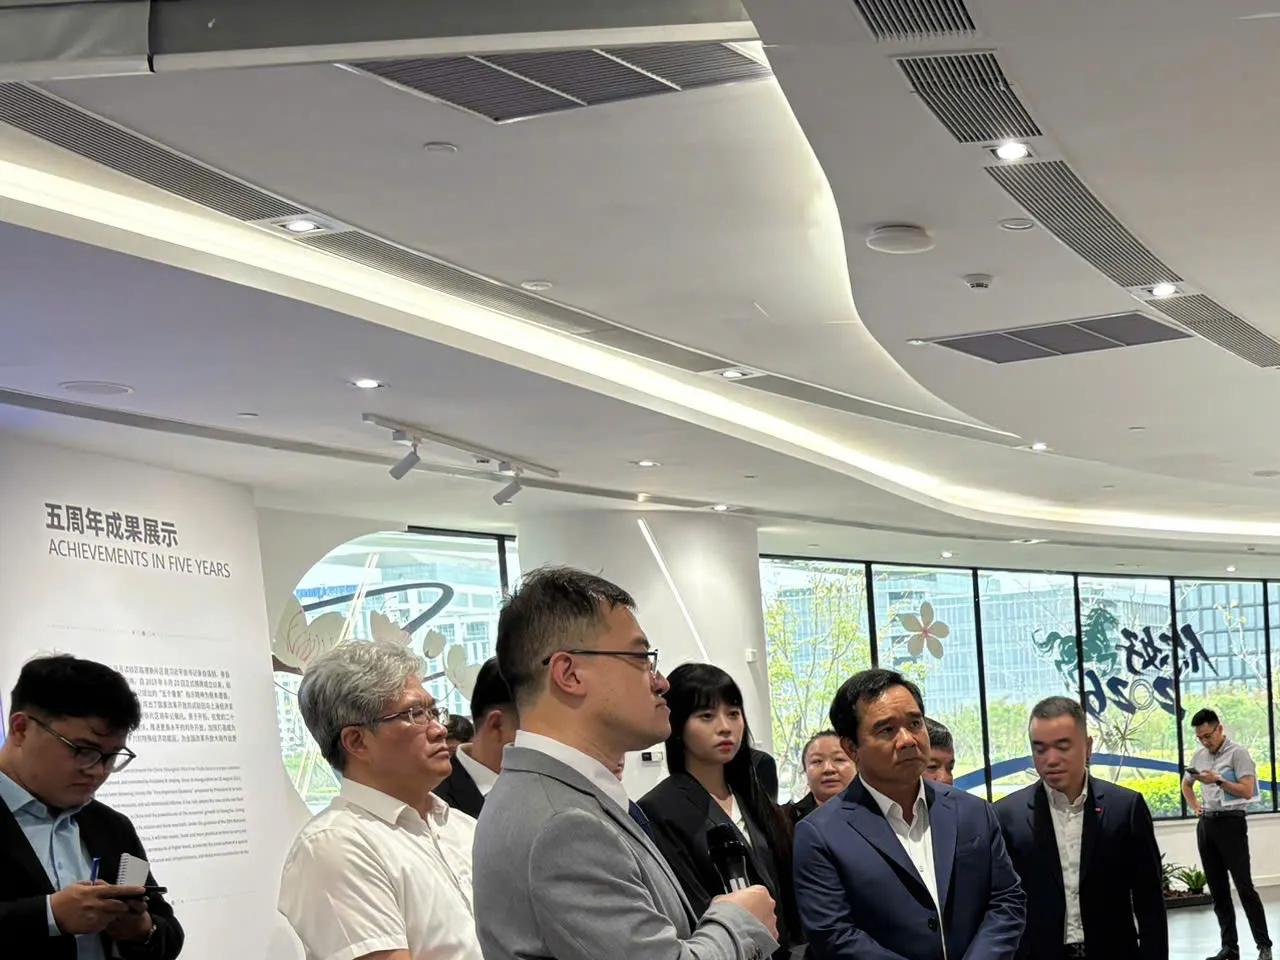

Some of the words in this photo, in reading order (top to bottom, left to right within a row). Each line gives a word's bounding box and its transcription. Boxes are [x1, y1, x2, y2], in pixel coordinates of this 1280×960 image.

[45, 503, 178, 548] 五周年成果展示
[49, 538, 149, 567] ACHIEVEMENTS
[152, 553, 165, 570] IN
[169, 555, 193, 574] FIVE
[195, 559, 231, 578] YEARS
